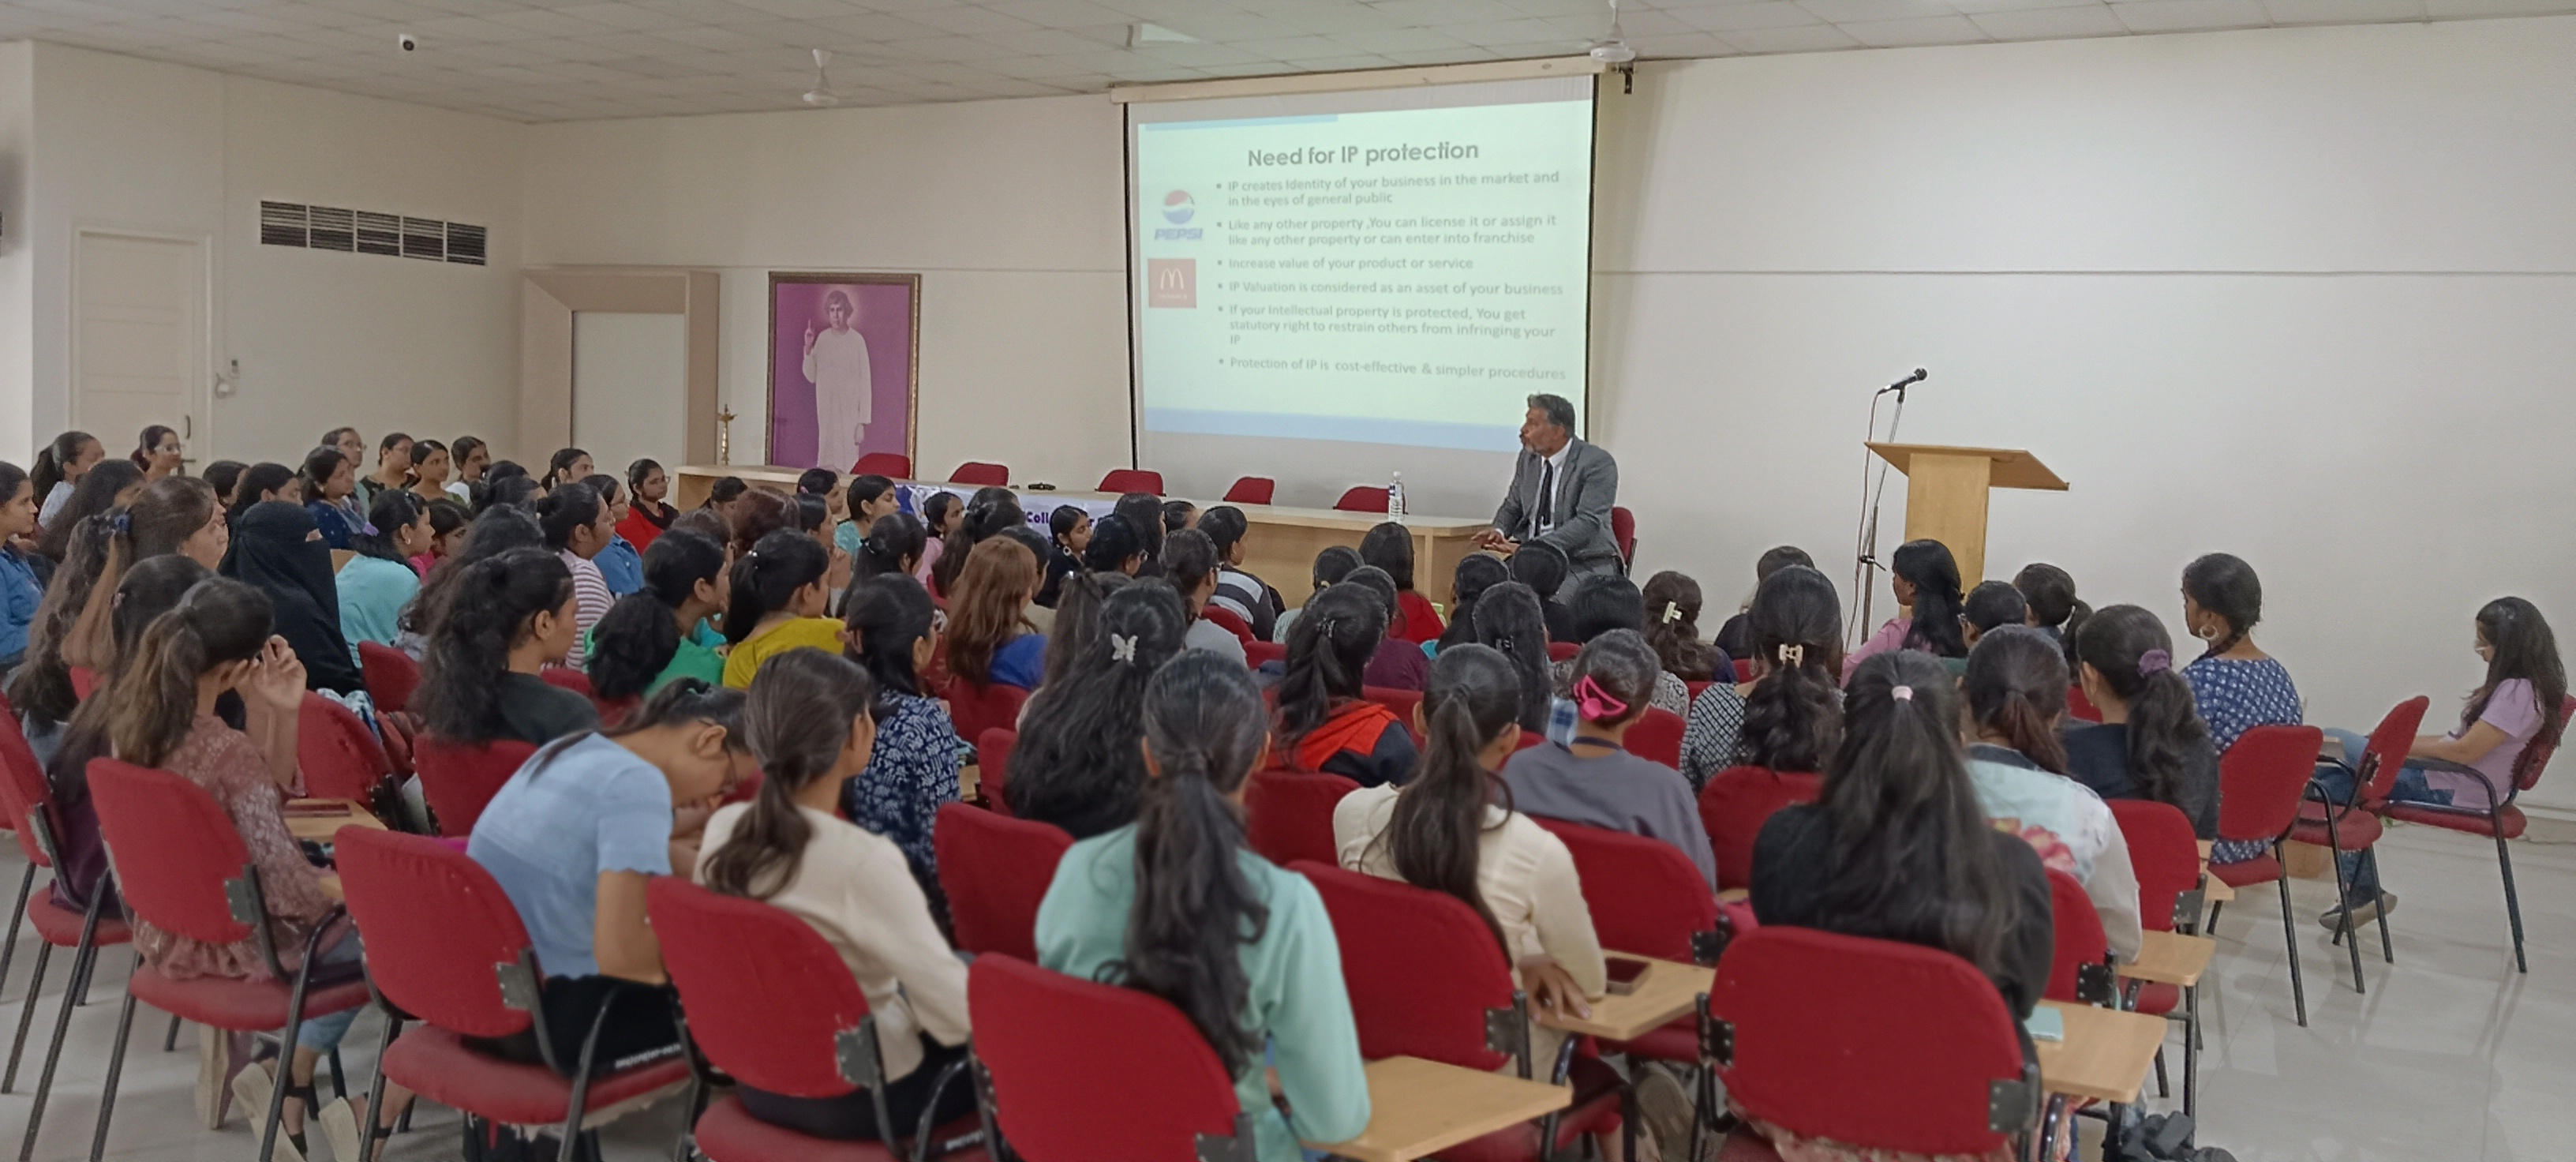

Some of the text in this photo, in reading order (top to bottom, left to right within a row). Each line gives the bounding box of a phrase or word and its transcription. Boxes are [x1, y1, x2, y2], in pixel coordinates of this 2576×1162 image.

[1248, 141, 1479, 167] Need for IP protection
[1228, 171, 1559, 191] IP creates Identity of your business in the market and
[1229, 193, 1393, 207] in the eyes of general public
[1229, 220, 1249, 230] Like
[1253, 221, 1272, 231] any
[1276, 219, 1308, 229] other
[1395, 218, 1417, 227] can
[1421, 216, 1466, 227] license
[1470, 216, 1479, 227] it
[1482, 217, 1497, 227] or
[1501, 216, 1542, 228] assign
[1547, 215, 1556, 226] it
[1155, 228, 1203, 240] PEPSI
[1229, 232, 1535, 249] like any other property or can enter into franchise
[1229, 257, 1473, 271] Increase value of your product or service
[1229, 282, 1563, 296] IP Valuation is considered as an asset of your business
[1230, 305, 1526, 322] If your Intellectual property is protected, You get
[1230, 320, 1555, 339] statutory right to restrain others from infringing your
[1230, 335, 1241, 344] IP
[1230, 358, 1567, 380] Protection of IP is cost-effective & simpler procedures
[1026, 512, 1048, 524] Coll
